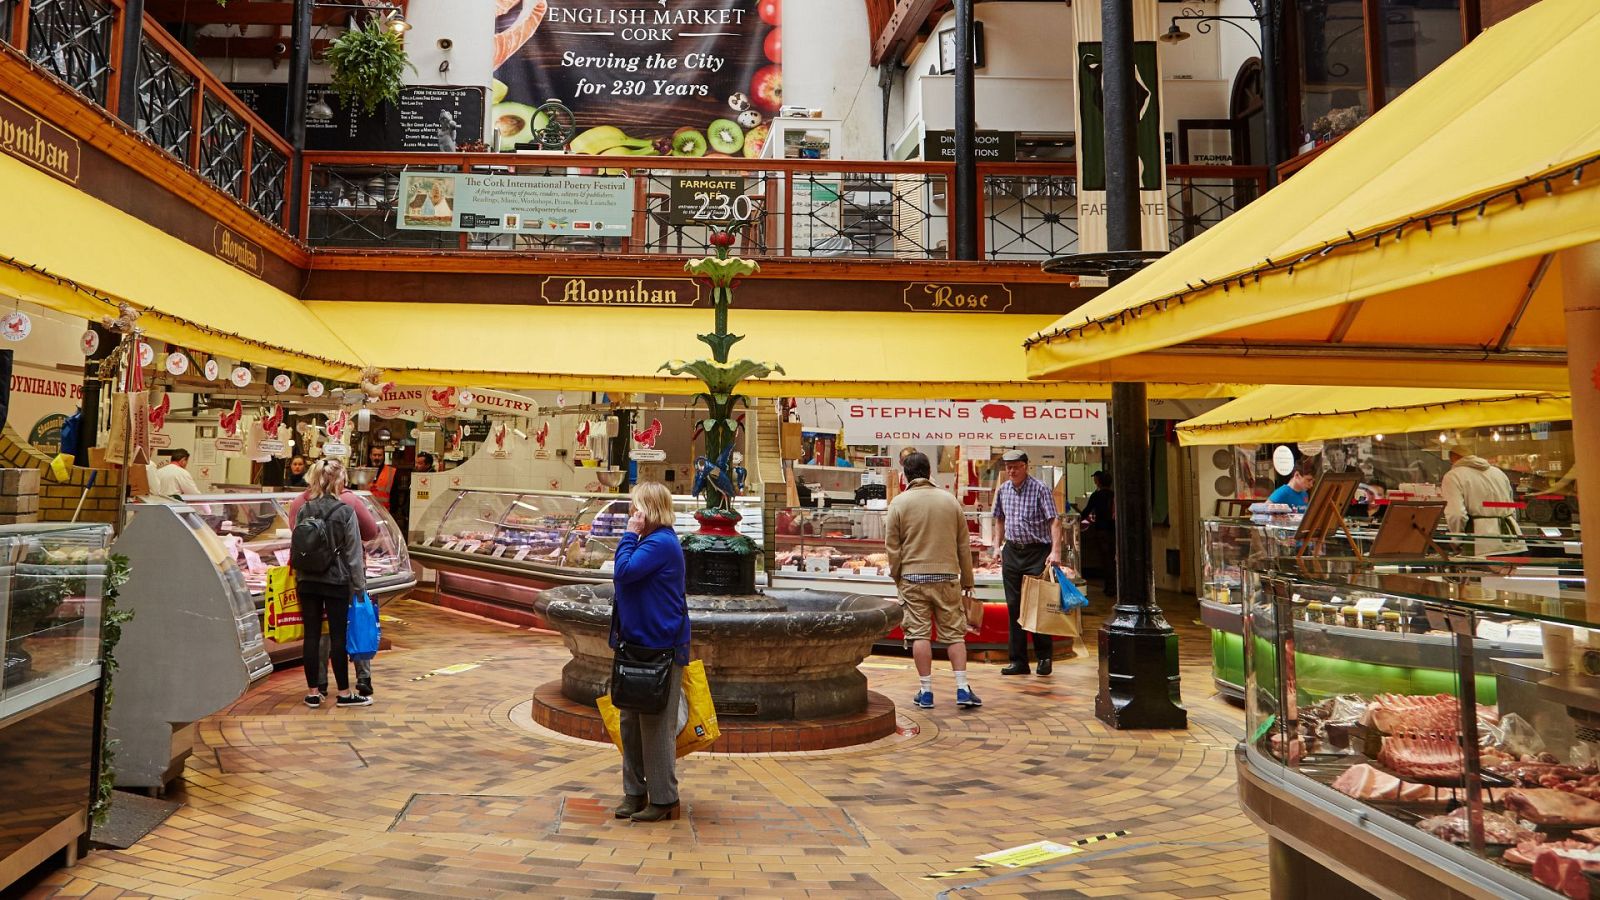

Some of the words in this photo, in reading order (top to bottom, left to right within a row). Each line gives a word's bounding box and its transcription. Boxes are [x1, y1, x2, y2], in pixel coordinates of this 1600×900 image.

[548, 8, 645, 25] ENGLISH
[653, 9, 746, 25] MARKET
[621, 28, 673, 41] CORK
[561, 50, 640, 72] Serving
[645, 53, 677, 69] the
[684, 53, 724, 73] City
[574, 78, 606, 98] for
[611, 80, 645, 96] 230
[653, 80, 709, 96] Years
[465, 177, 481, 187] The
[483, 178, 505, 188] Cork
[507, 179, 562, 189] International
[564, 181, 592, 191] Poetry
[594, 181, 626, 190] Festival
[680, 180, 736, 189] FARMGATE
[473, 196, 499, 204] Readings,
[492, 190, 518, 198] gathering
[694, 191, 722, 200] CFÉ
[693, 194, 752, 221] 230
[220, 230, 257, 271] Moynihan
[560, 278, 677, 304] Moynihan
[924, 284, 989, 308] Rose
[10, 375, 67, 398] OYNIHANS
[379, 390, 422, 402] IHANS
[850, 403, 970, 418] STEPHEN'S
[1023, 406, 1099, 419] BACON
